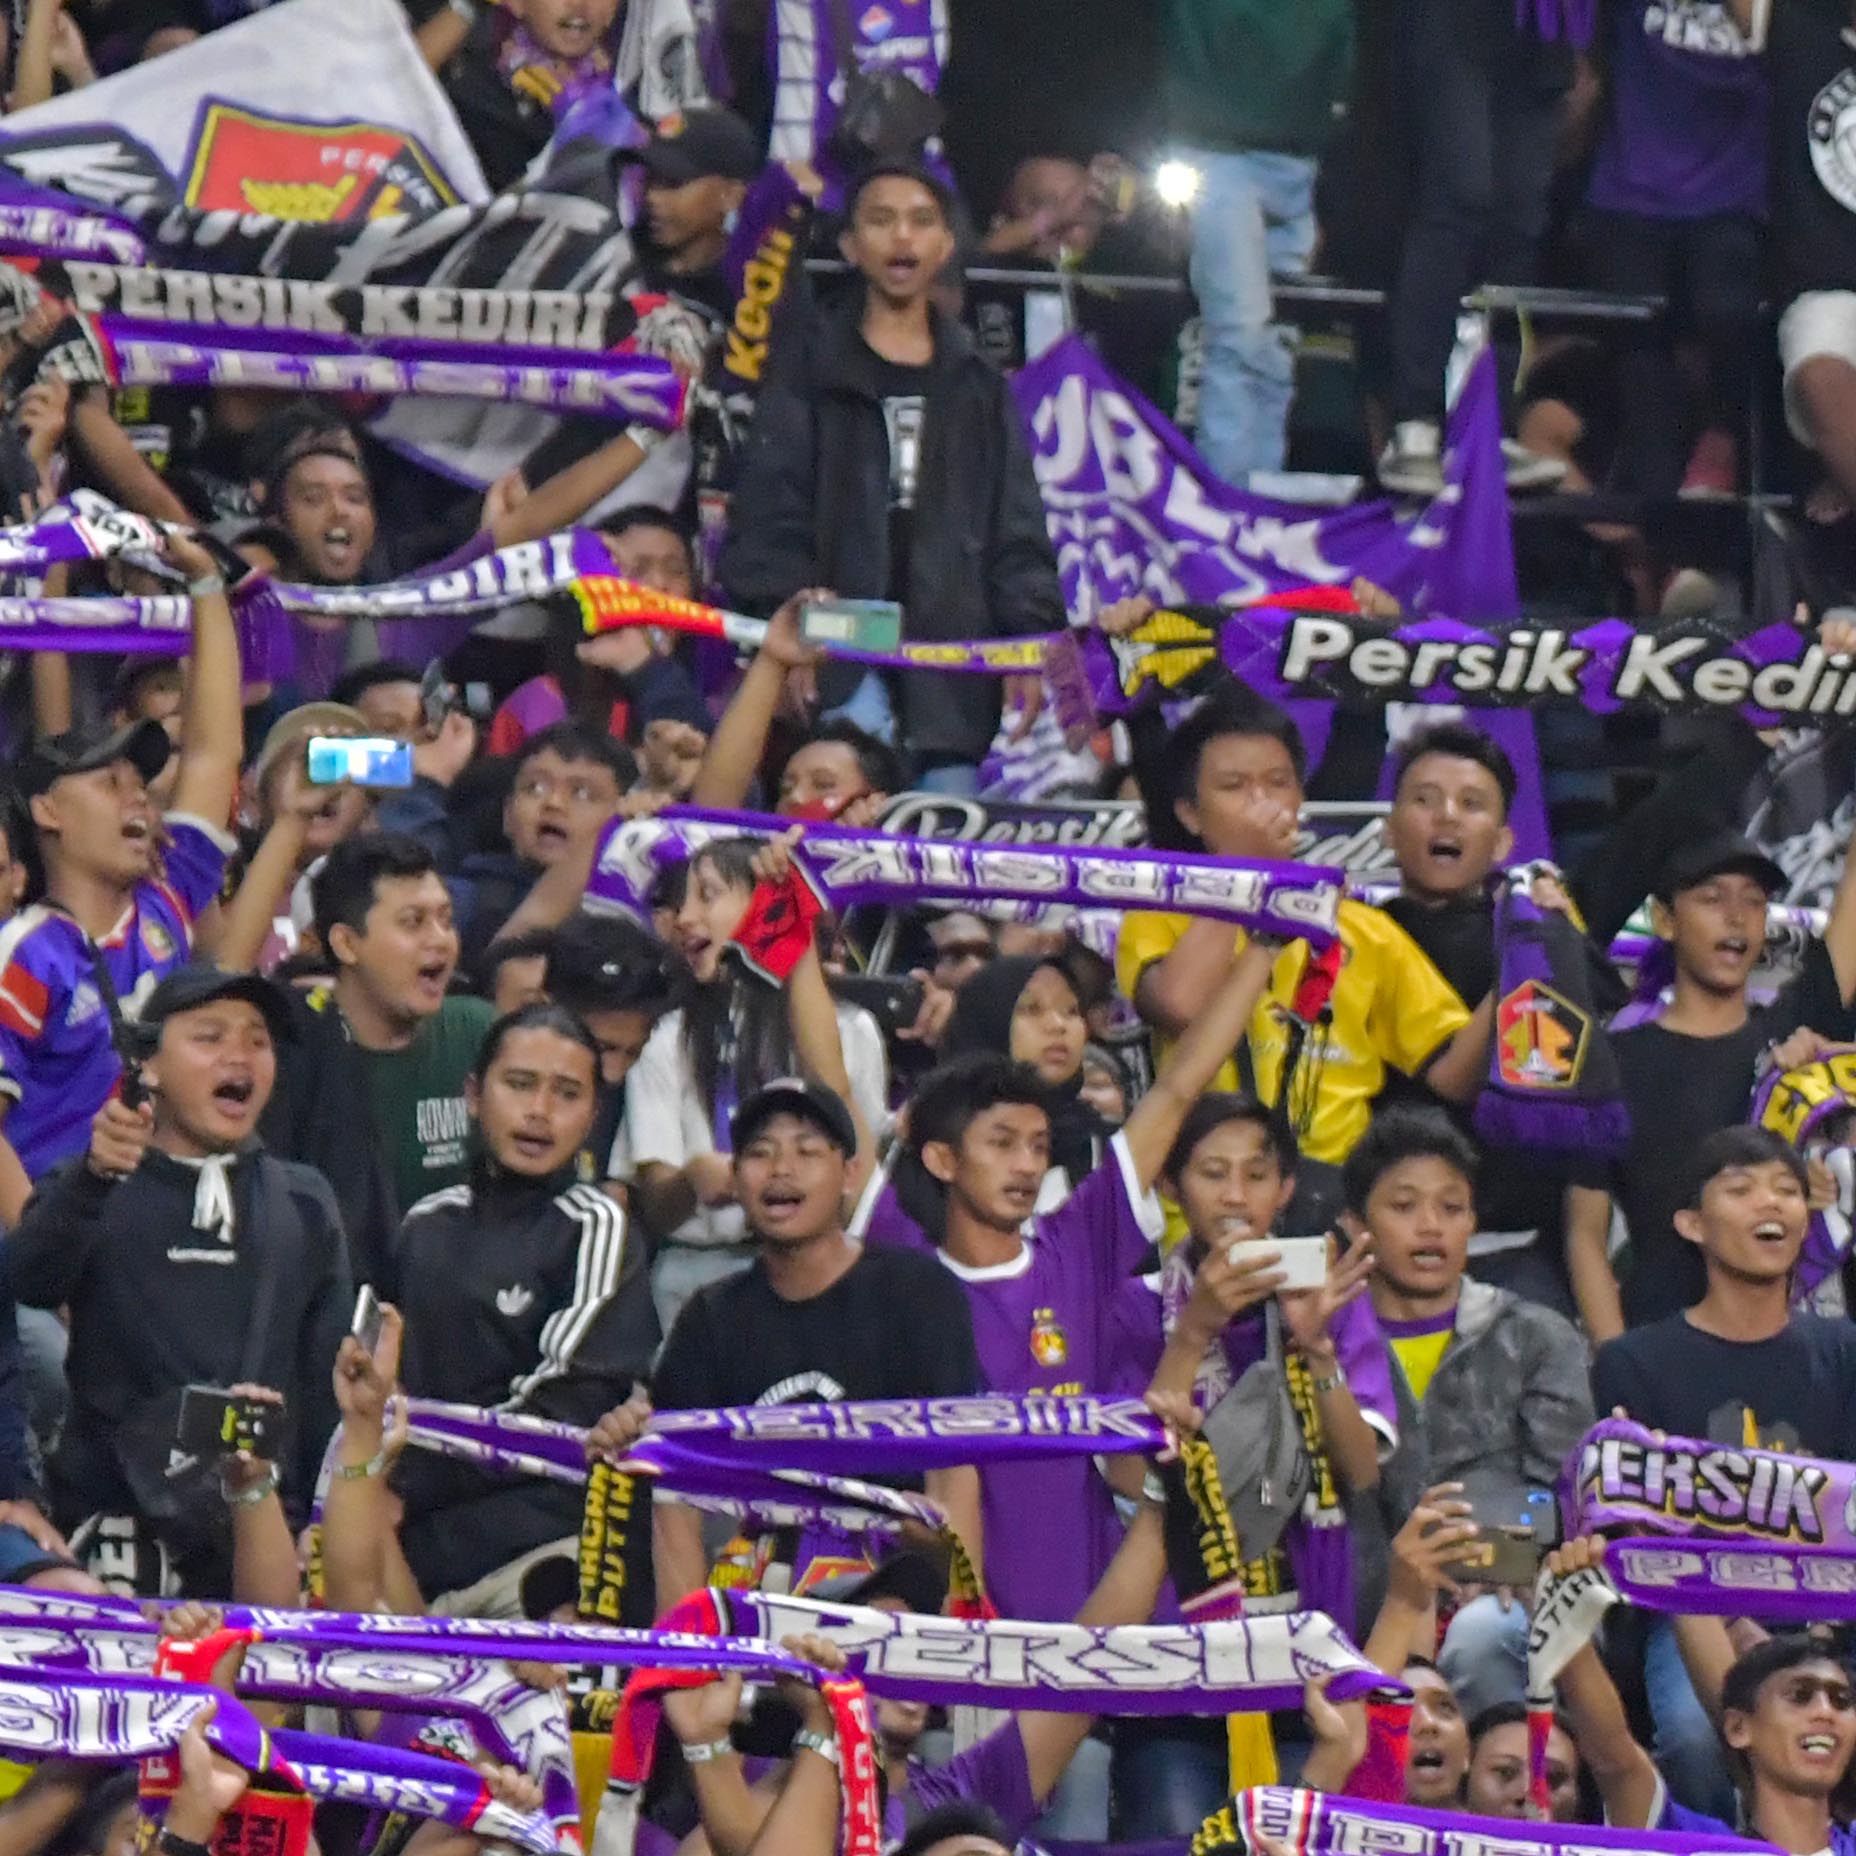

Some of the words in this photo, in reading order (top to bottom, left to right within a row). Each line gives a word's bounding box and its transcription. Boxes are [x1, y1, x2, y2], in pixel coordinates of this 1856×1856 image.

[65, 261, 347, 335] PERSIK
[360, 286, 615, 350] KEDIRI
[1286, 618, 1583, 695] Persik
[905, 803, 1146, 850] Persik
[661, 1401, 1151, 1438] PERSIK
[748, 1595, 1362, 1690] PERSIK
